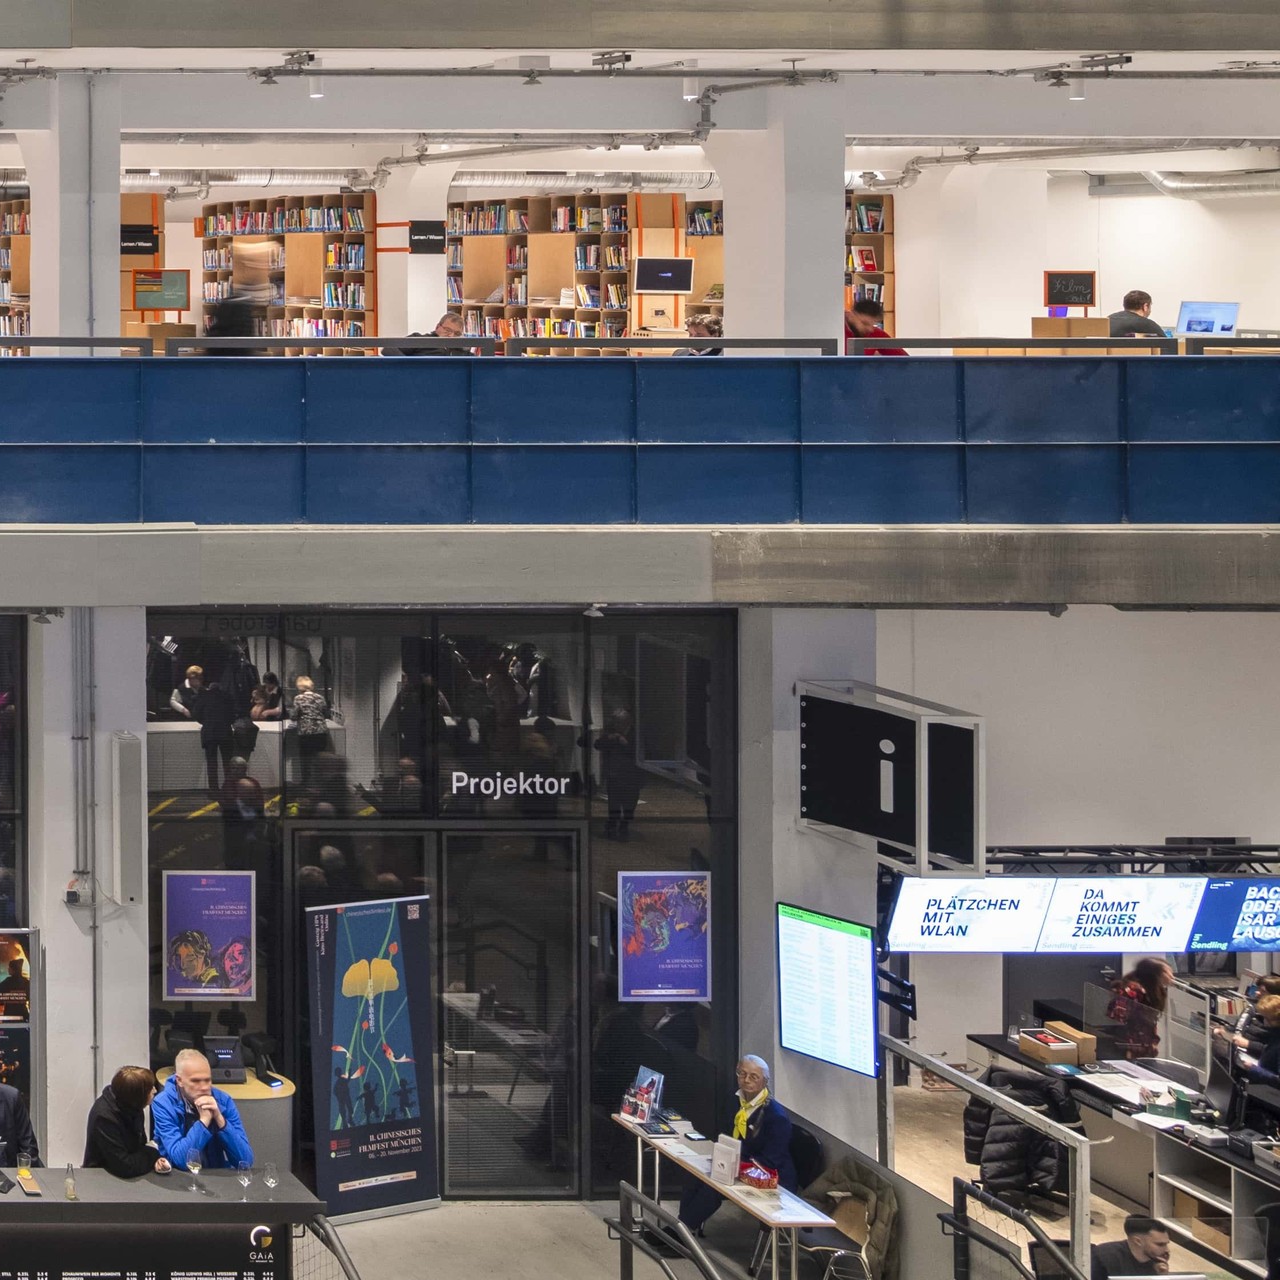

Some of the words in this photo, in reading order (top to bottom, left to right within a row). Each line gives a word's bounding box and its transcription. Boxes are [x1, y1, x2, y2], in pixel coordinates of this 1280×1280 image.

[452, 771, 570, 800] Projektor
[1084, 889, 1104, 900] DA
[926, 896, 1020, 910] PLÄTZCHEN
[1080, 901, 1140, 912] KOMMT
[923, 912, 954, 923] MIT
[1076, 914, 1137, 925] EINIGES
[1237, 913, 1277, 926] ISAR
[920, 925, 968, 936] WLAN
[1072, 927, 1162, 937] ZUSAMMEN
[890, 941, 927, 949] Sendling
[1042, 941, 1078, 950] Sendling
[1191, 942, 1228, 950] Sendling
[376, 1127, 422, 1141] CHINESISCHES
[359, 1142, 389, 1153] FILMFEST
[390, 1137, 422, 1148] MÜNCHEN
[388, 1147, 410, 1156] November
[249, 1252, 274, 1260] GAiA
